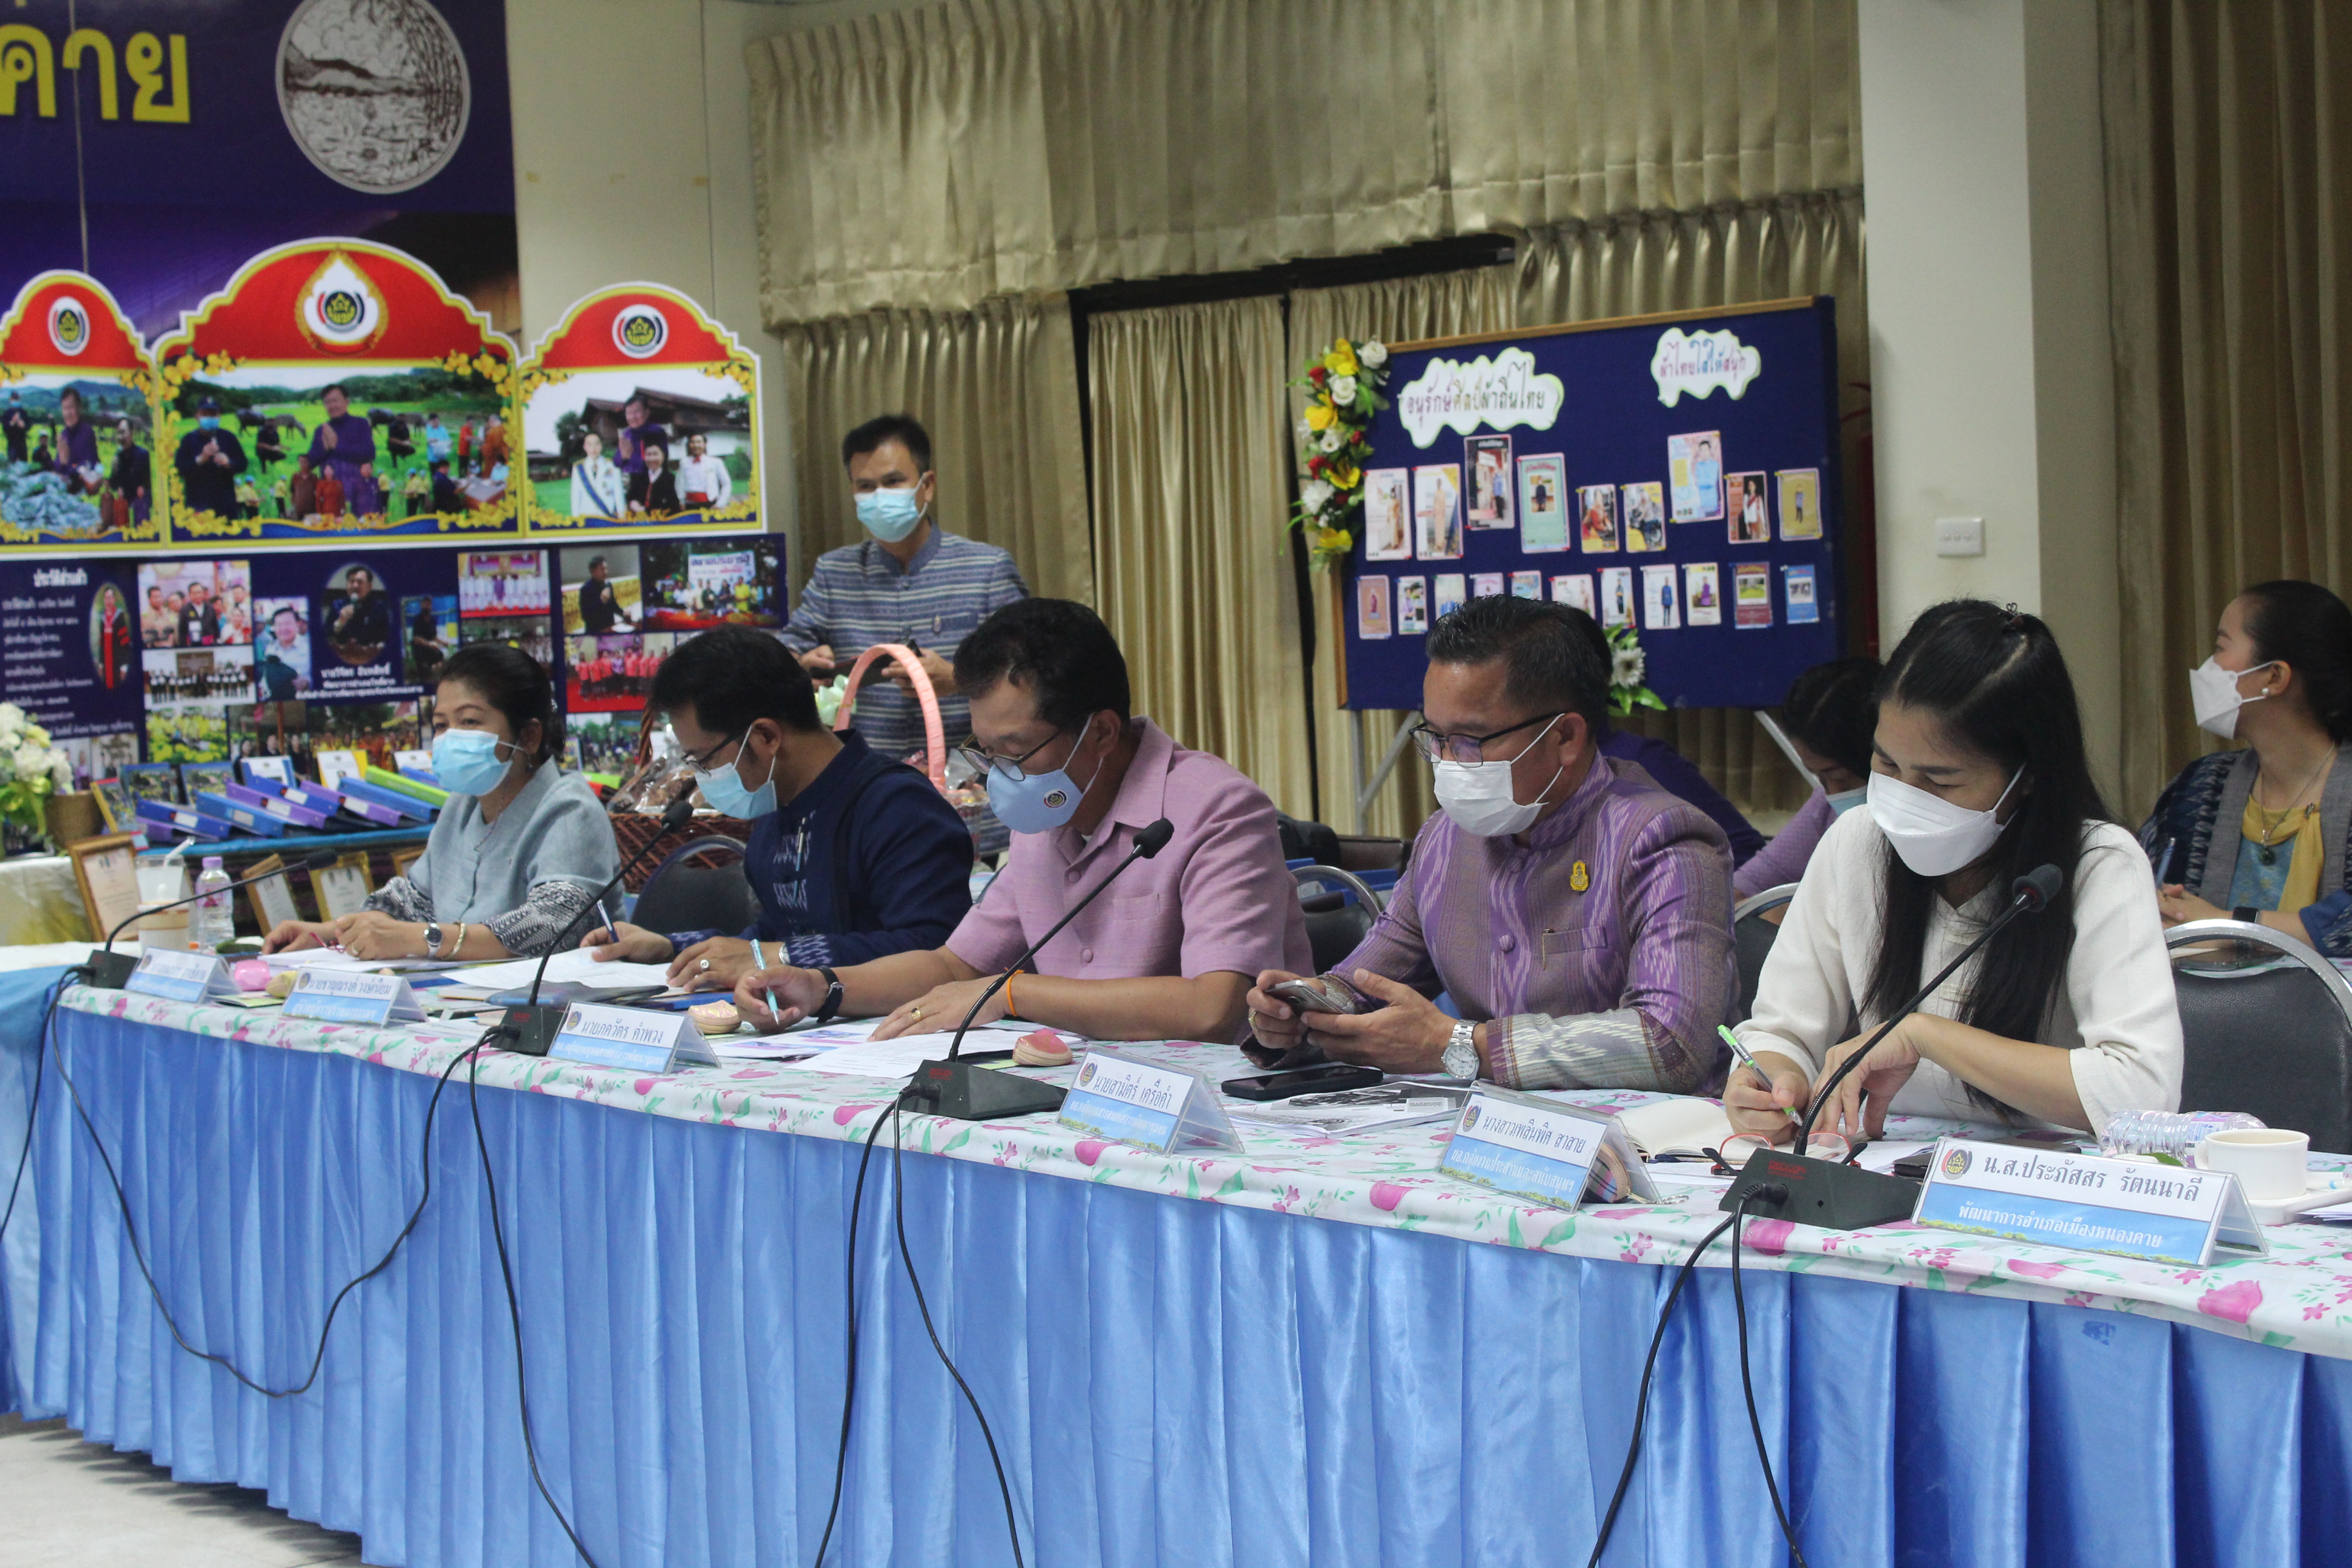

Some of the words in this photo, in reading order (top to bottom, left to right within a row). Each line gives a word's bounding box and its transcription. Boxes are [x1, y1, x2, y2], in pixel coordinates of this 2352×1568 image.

[581, 1019, 629, 1039] นายภควัตร
[632, 1022, 664, 1044] คำพวง
[1093, 1074, 1143, 1100] นายสามิตร์
[1139, 1078, 1172, 1109] เครือคำ
[1482, 1115, 1553, 1145] นางสาวเพลินพิศ
[1554, 1133, 1587, 1154] สาสาย
[1983, 1155, 2107, 1188] น.ส.ประภัสสร
[2120, 1167, 2203, 1202] รัตนนาลี
[1959, 1200, 2162, 1248] พัฒนาการอำเภอเมืองหนองคาย
